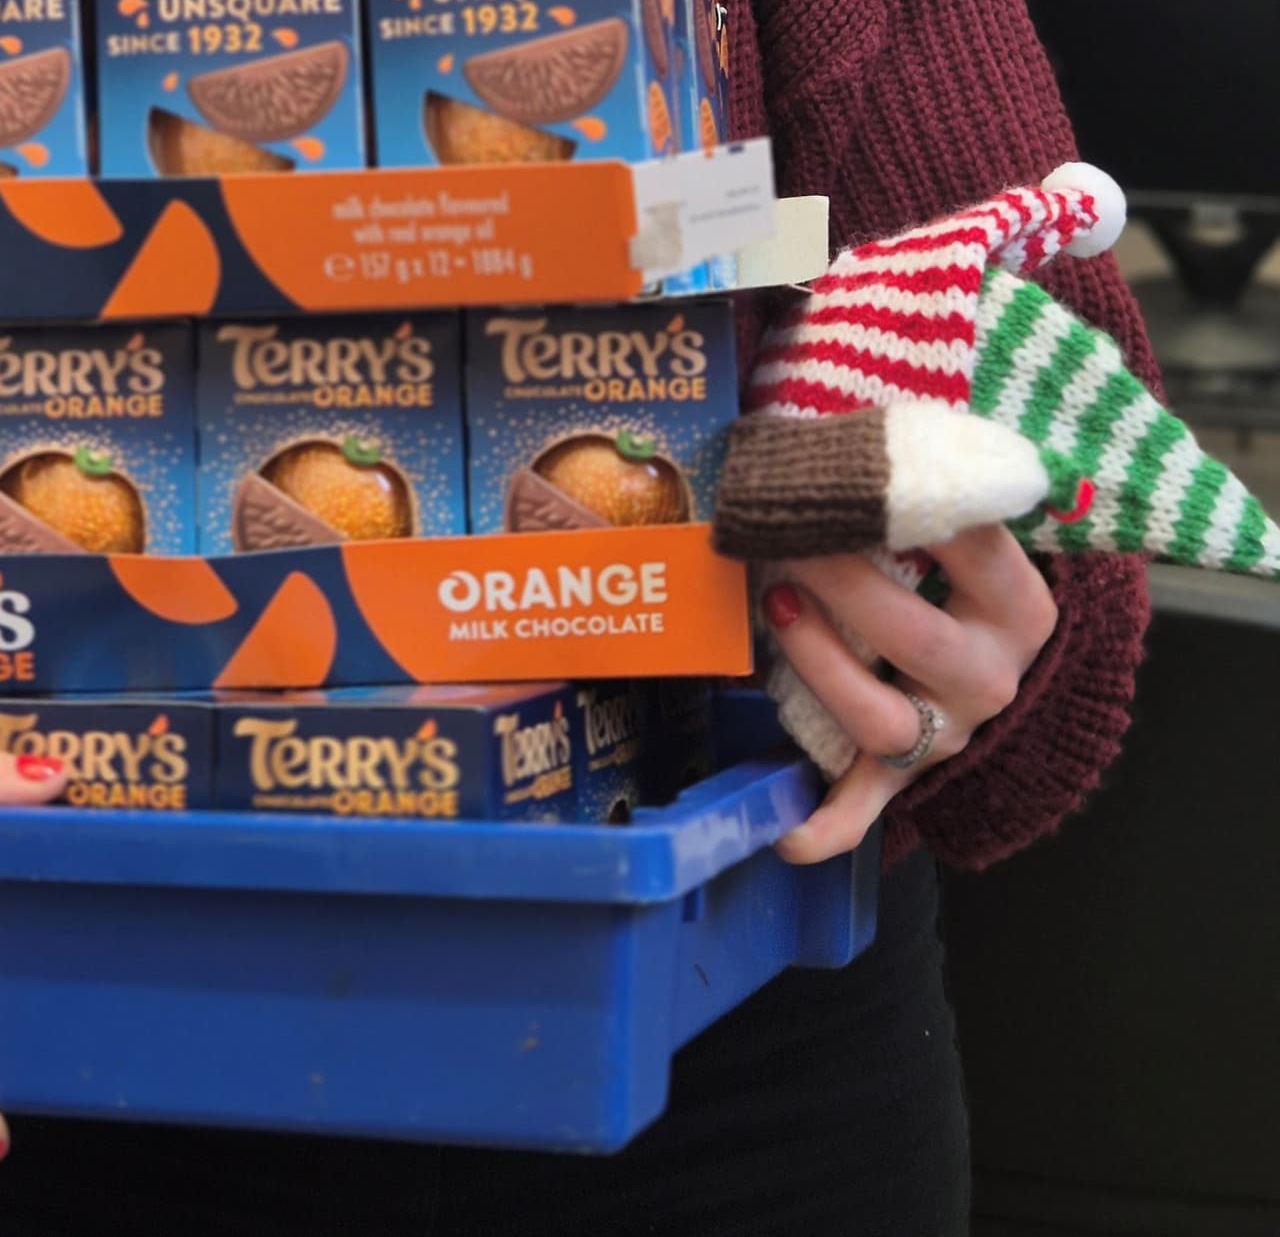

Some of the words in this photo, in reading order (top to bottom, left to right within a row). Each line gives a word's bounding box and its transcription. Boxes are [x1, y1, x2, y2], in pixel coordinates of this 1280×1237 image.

[379, 14, 456, 40] SINCE
[461, 4, 540, 36] 1932
[107, 33, 181, 58] SINCE
[187, 24, 264, 55] 1932
[312, 383, 433, 409] ORANGE
[583, 376, 707, 403] ORANGE
[44, 393, 164, 420] ORANGE
[438, 562, 669, 614] ORANGE
[448, 620, 509, 642] MILK
[514, 612, 665, 639] CHOCOLATE
[331, 790, 459, 818] ORANGE
